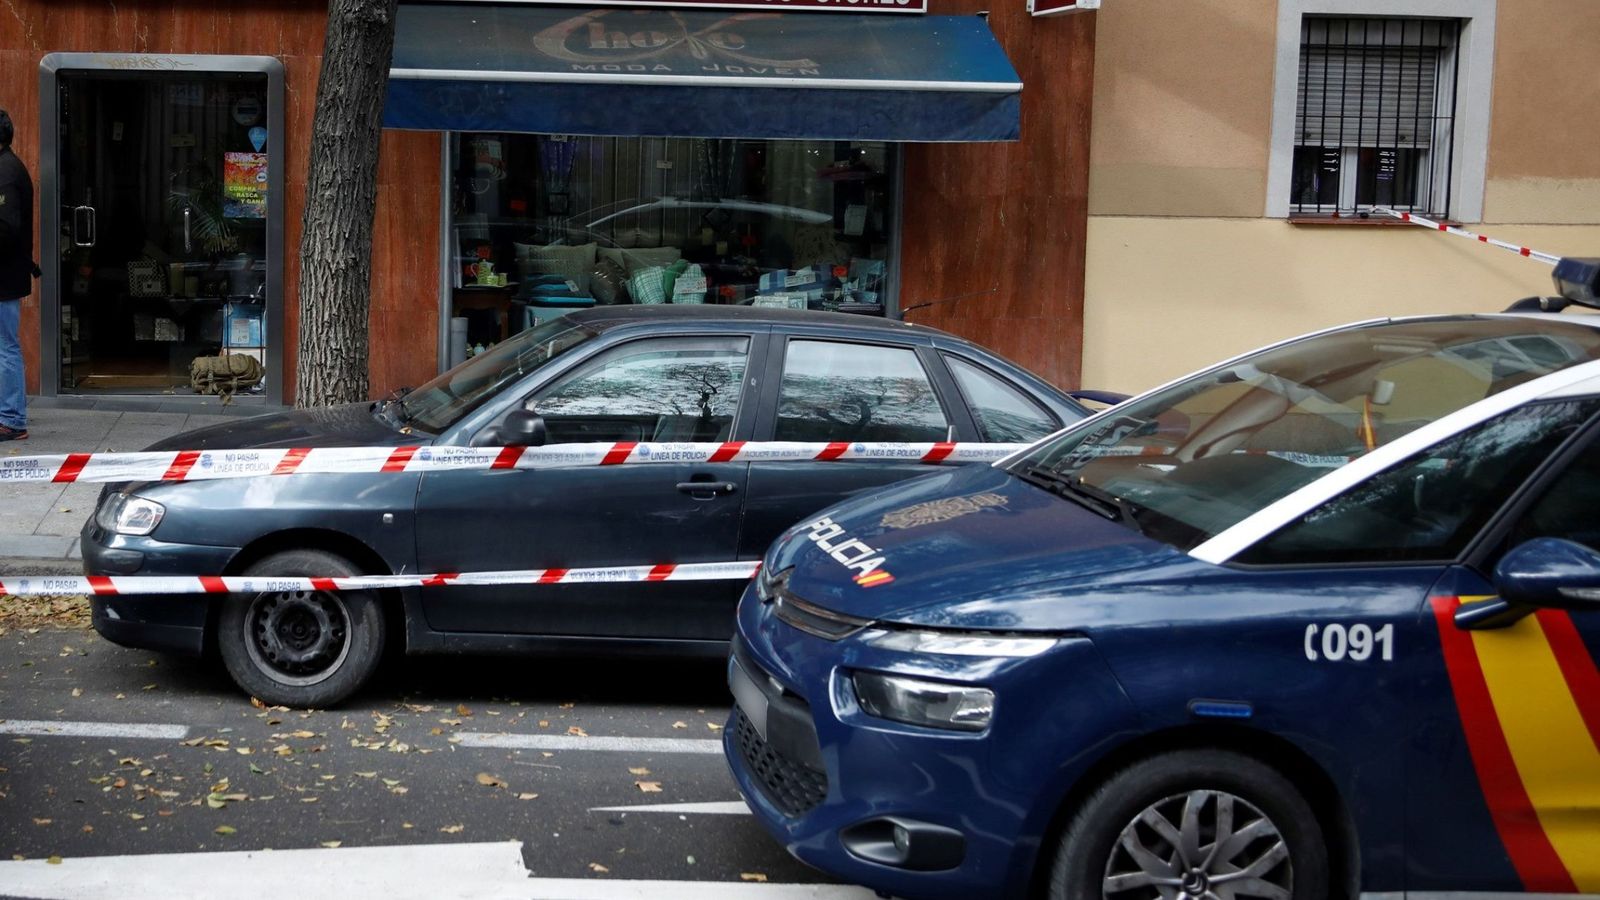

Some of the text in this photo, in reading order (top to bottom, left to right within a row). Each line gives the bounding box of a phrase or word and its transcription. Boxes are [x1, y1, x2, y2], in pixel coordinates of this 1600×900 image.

[571, 63, 820, 75] MODA JOVEN
[225, 453, 260, 463] NO PASAR
[651, 451, 707, 461] LINEA DE POLICIA
[865, 449, 921, 457] LINEA DE POLICIA
[3, 459, 39, 468] NO PASAR
[432, 455, 489, 465] LINEA DE POLICIA
[213, 462, 270, 473] LINEA DE POLICIA
[14, 469, 24, 478] DE
[25, 468, 50, 478] POLICIA
[798, 517, 886, 577] POLICÍA
[43, 580, 78, 589] NO PASAR
[266, 581, 301, 591] NO PASAR
[1322, 623, 1393, 661] 091
